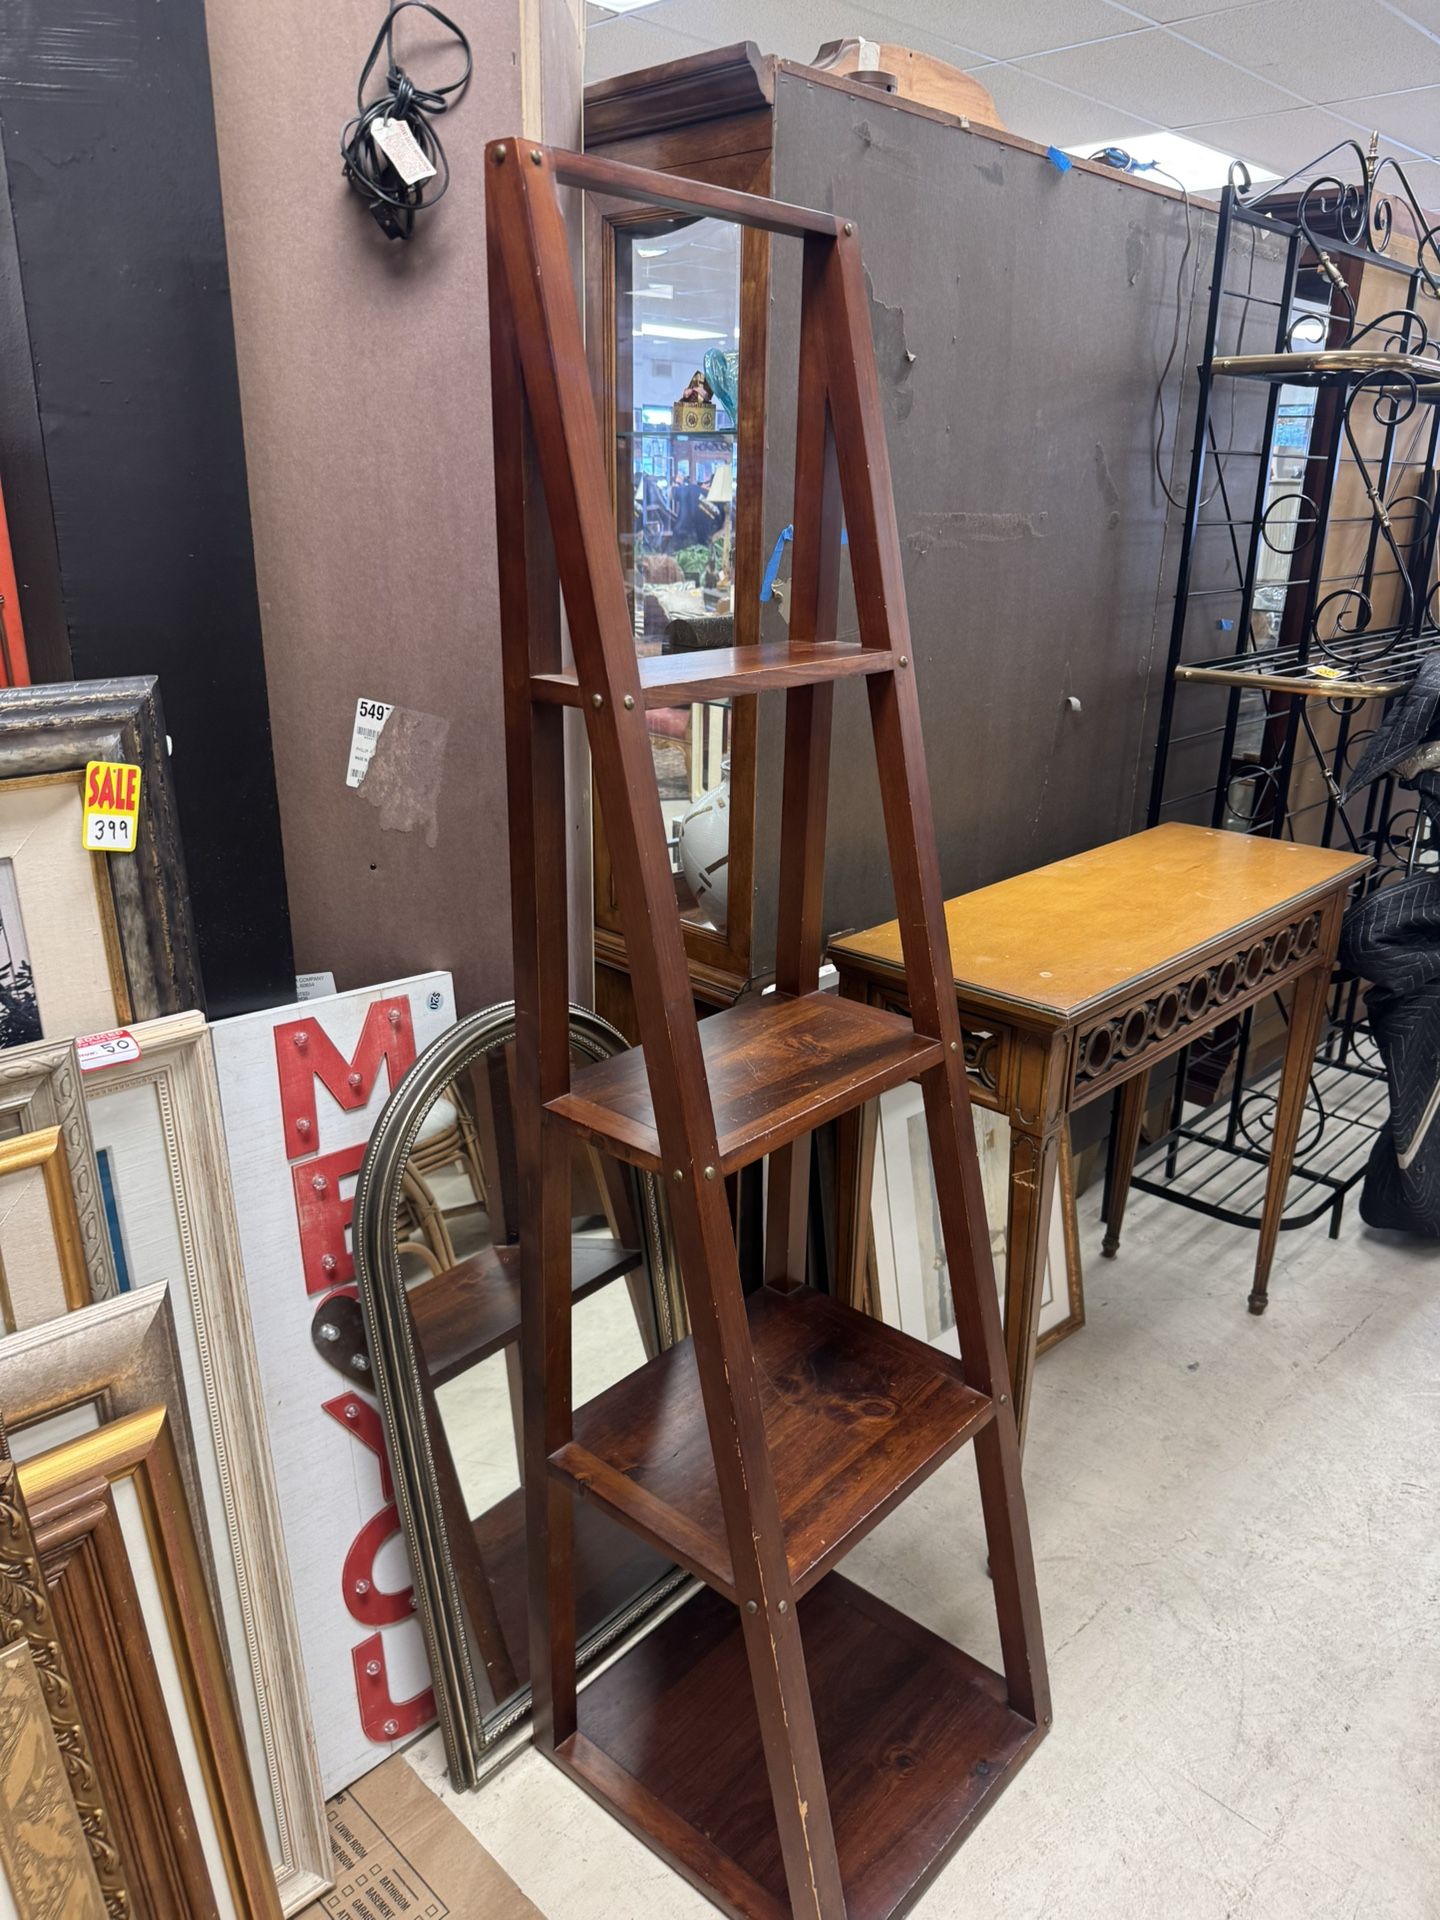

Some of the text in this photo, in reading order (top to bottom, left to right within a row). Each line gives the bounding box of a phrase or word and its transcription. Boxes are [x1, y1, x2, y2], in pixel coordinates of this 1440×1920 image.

[88, 765, 137, 811] SALE
[95, 820, 128, 840] 399
[100, 1040, 130, 1054] 50
[334, 1821, 355, 1843] LIVING
[348, 1838, 369, 1860] ROOM
[335, 1849, 356, 1871] ROOM
[365, 1886, 396, 1920] BASEMENT
[379, 1875, 412, 1912] BATHROOM
